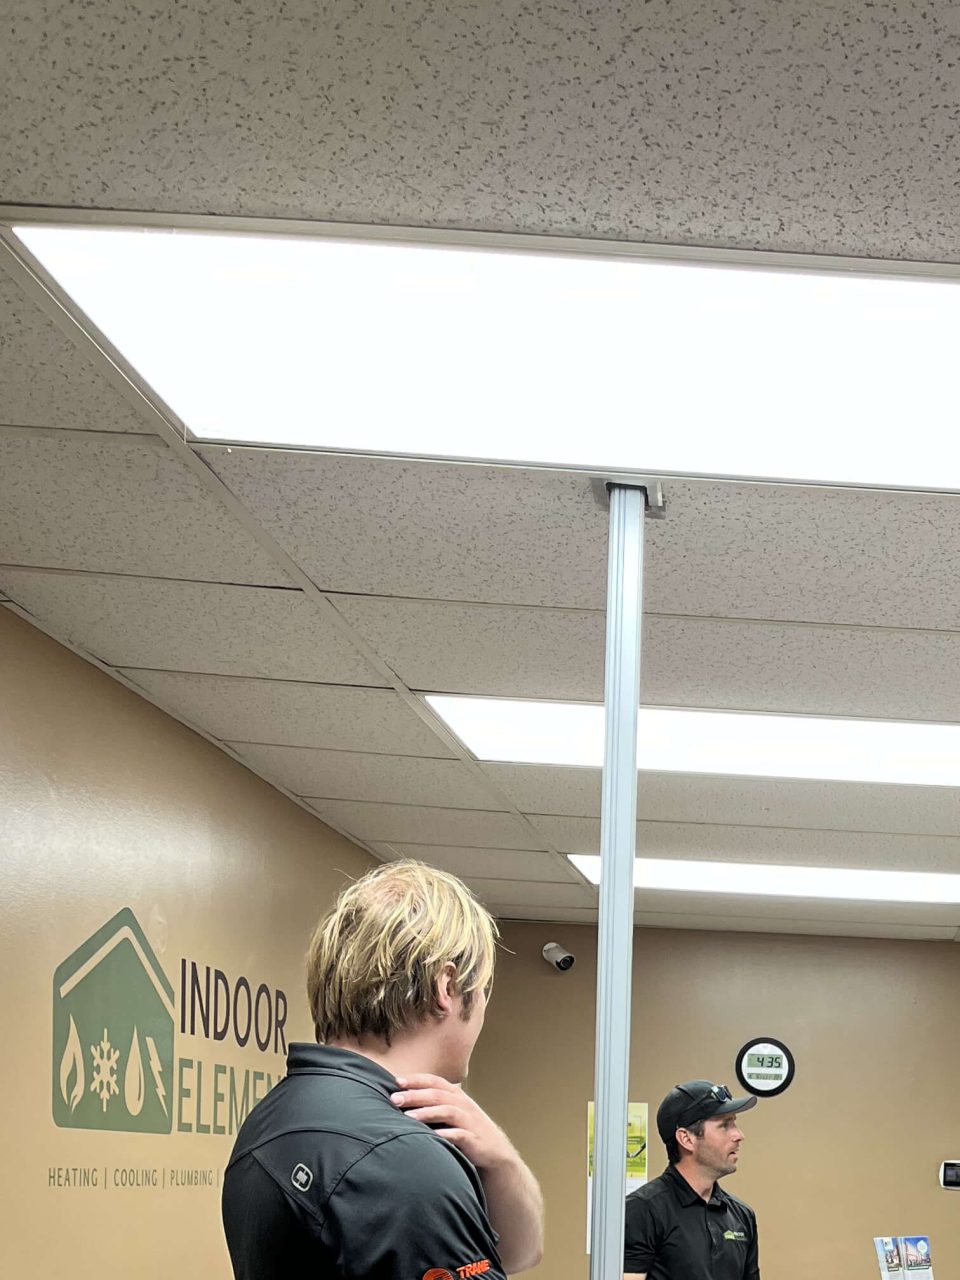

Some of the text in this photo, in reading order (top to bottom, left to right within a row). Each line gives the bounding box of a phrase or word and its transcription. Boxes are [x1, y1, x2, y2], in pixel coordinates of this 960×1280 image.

[180, 958, 288, 1056] INDOOR
[177, 1057, 286, 1136] ELEME
[48, 1167, 213, 1187] HEATING COOLING PLUMBING
[456, 1259, 491, 1279] TRANE
